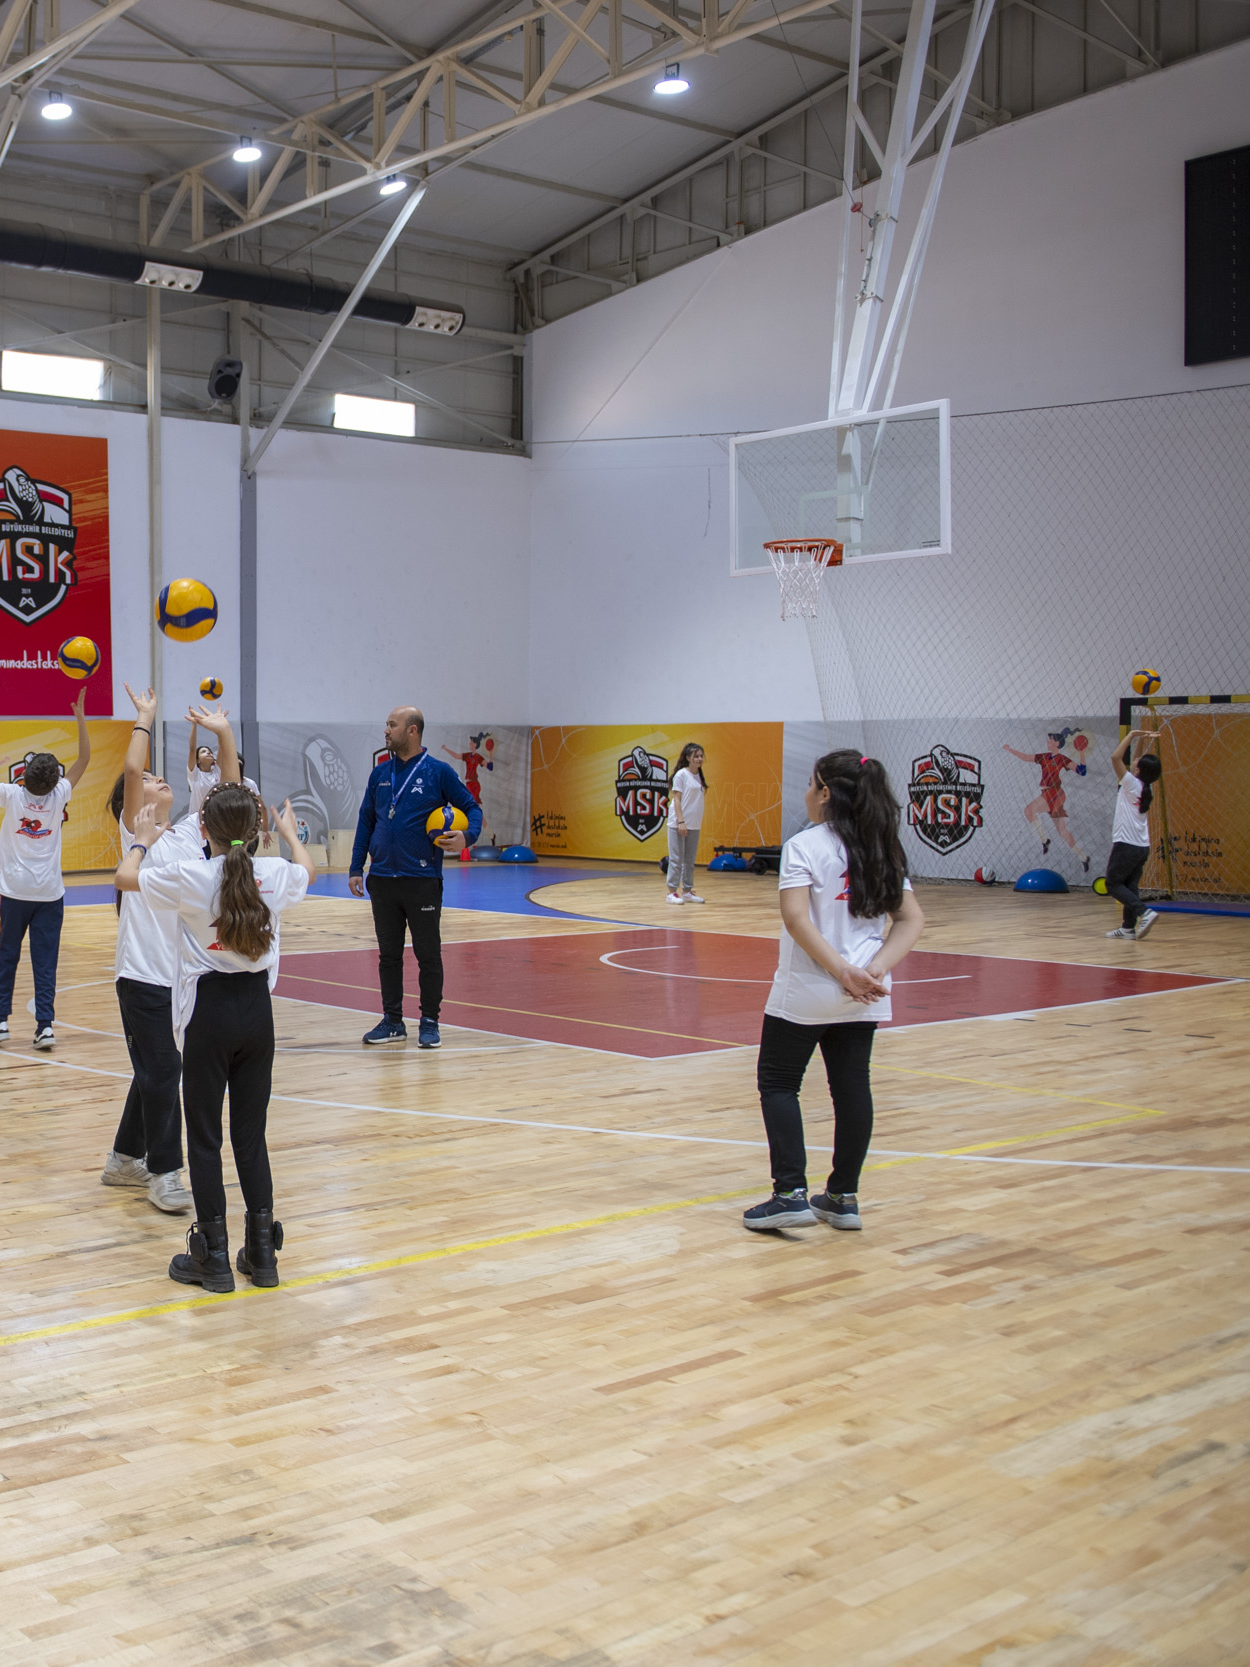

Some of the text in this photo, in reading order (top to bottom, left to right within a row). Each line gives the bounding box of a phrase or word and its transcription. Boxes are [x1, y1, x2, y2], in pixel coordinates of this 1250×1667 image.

[1, 522, 40, 533] BÜYÜKŞEHİR
[41, 526, 74, 538] BELEDİYESİ
[616, 788, 669, 817] MSK
[910, 794, 982, 827] MSK
